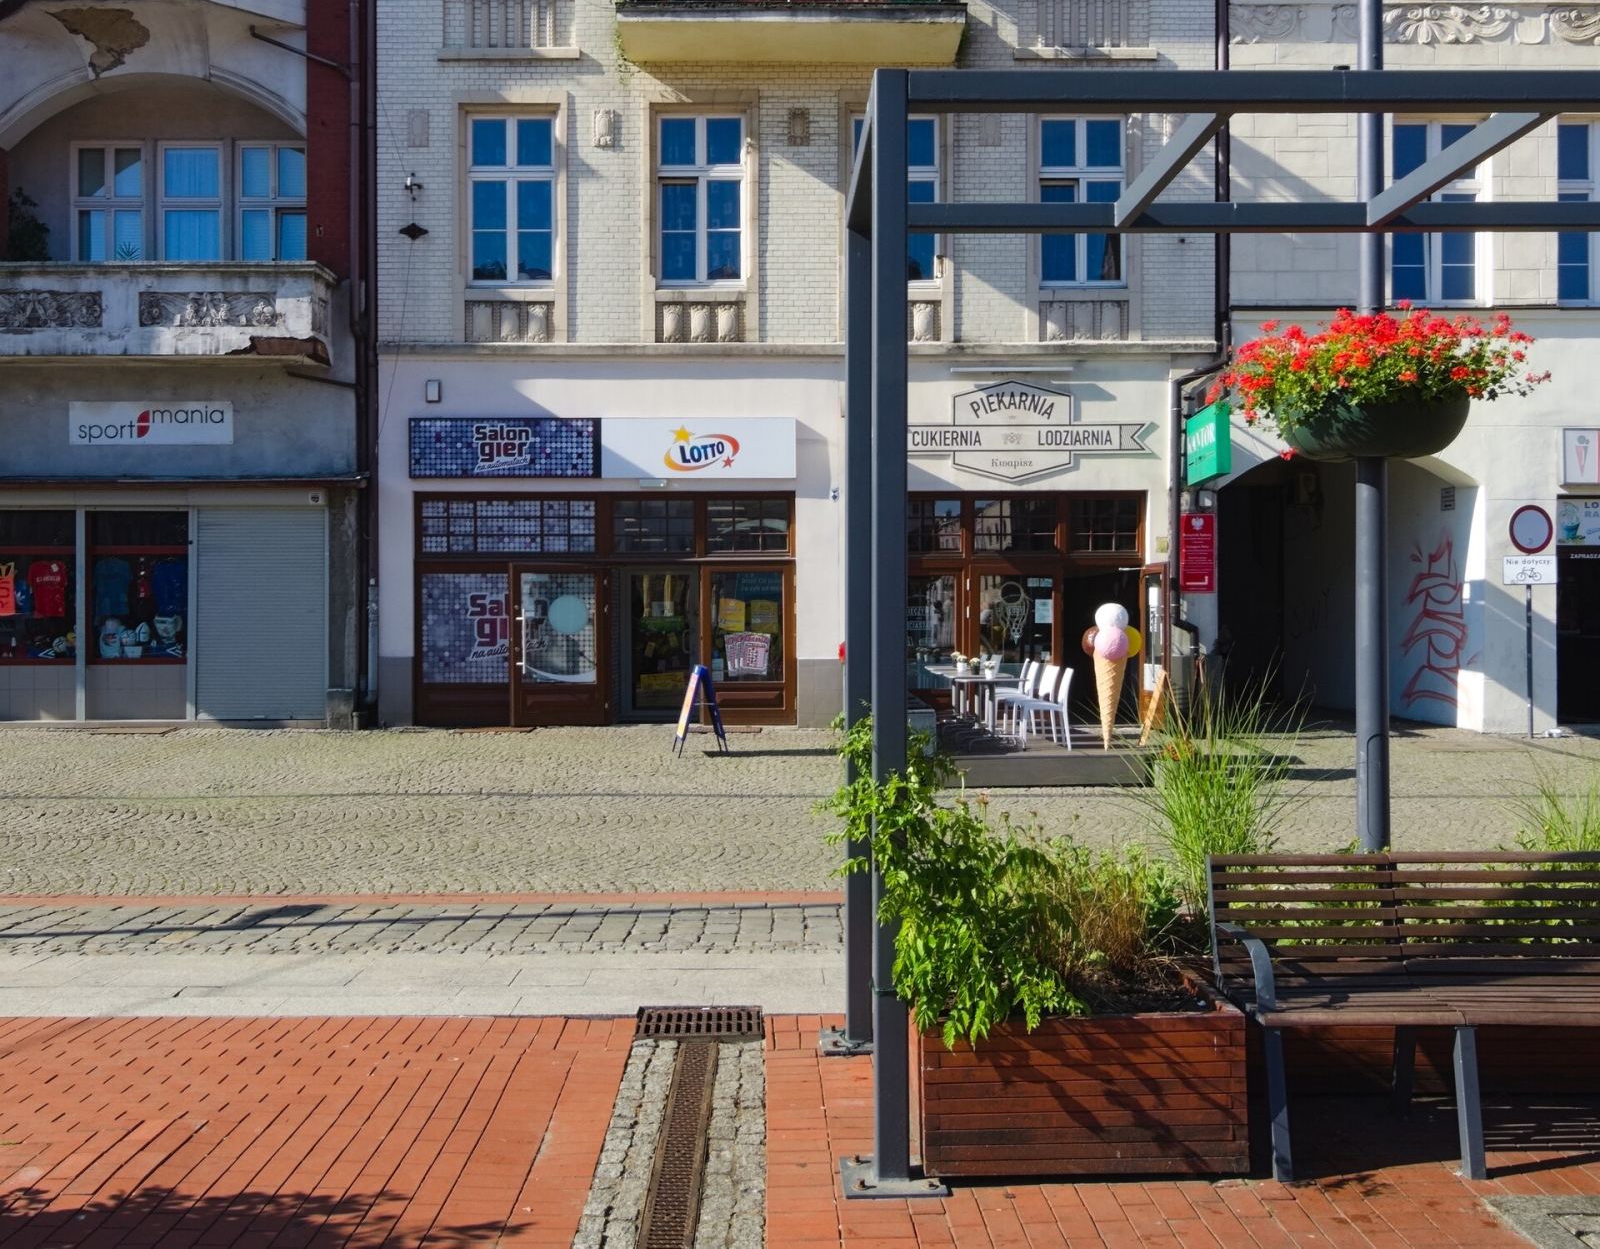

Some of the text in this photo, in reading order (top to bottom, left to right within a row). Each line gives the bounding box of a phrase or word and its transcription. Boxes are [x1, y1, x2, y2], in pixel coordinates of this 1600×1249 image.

[968, 391, 1056, 421] PIEKARNIA
[78, 405, 225, 443] sport mania
[474, 424, 530, 442] Salon
[911, 429, 1113, 447] CUKIERNIA LODZIARNIA
[479, 442, 528, 463] gier
[679, 441, 725, 464] LOTTO
